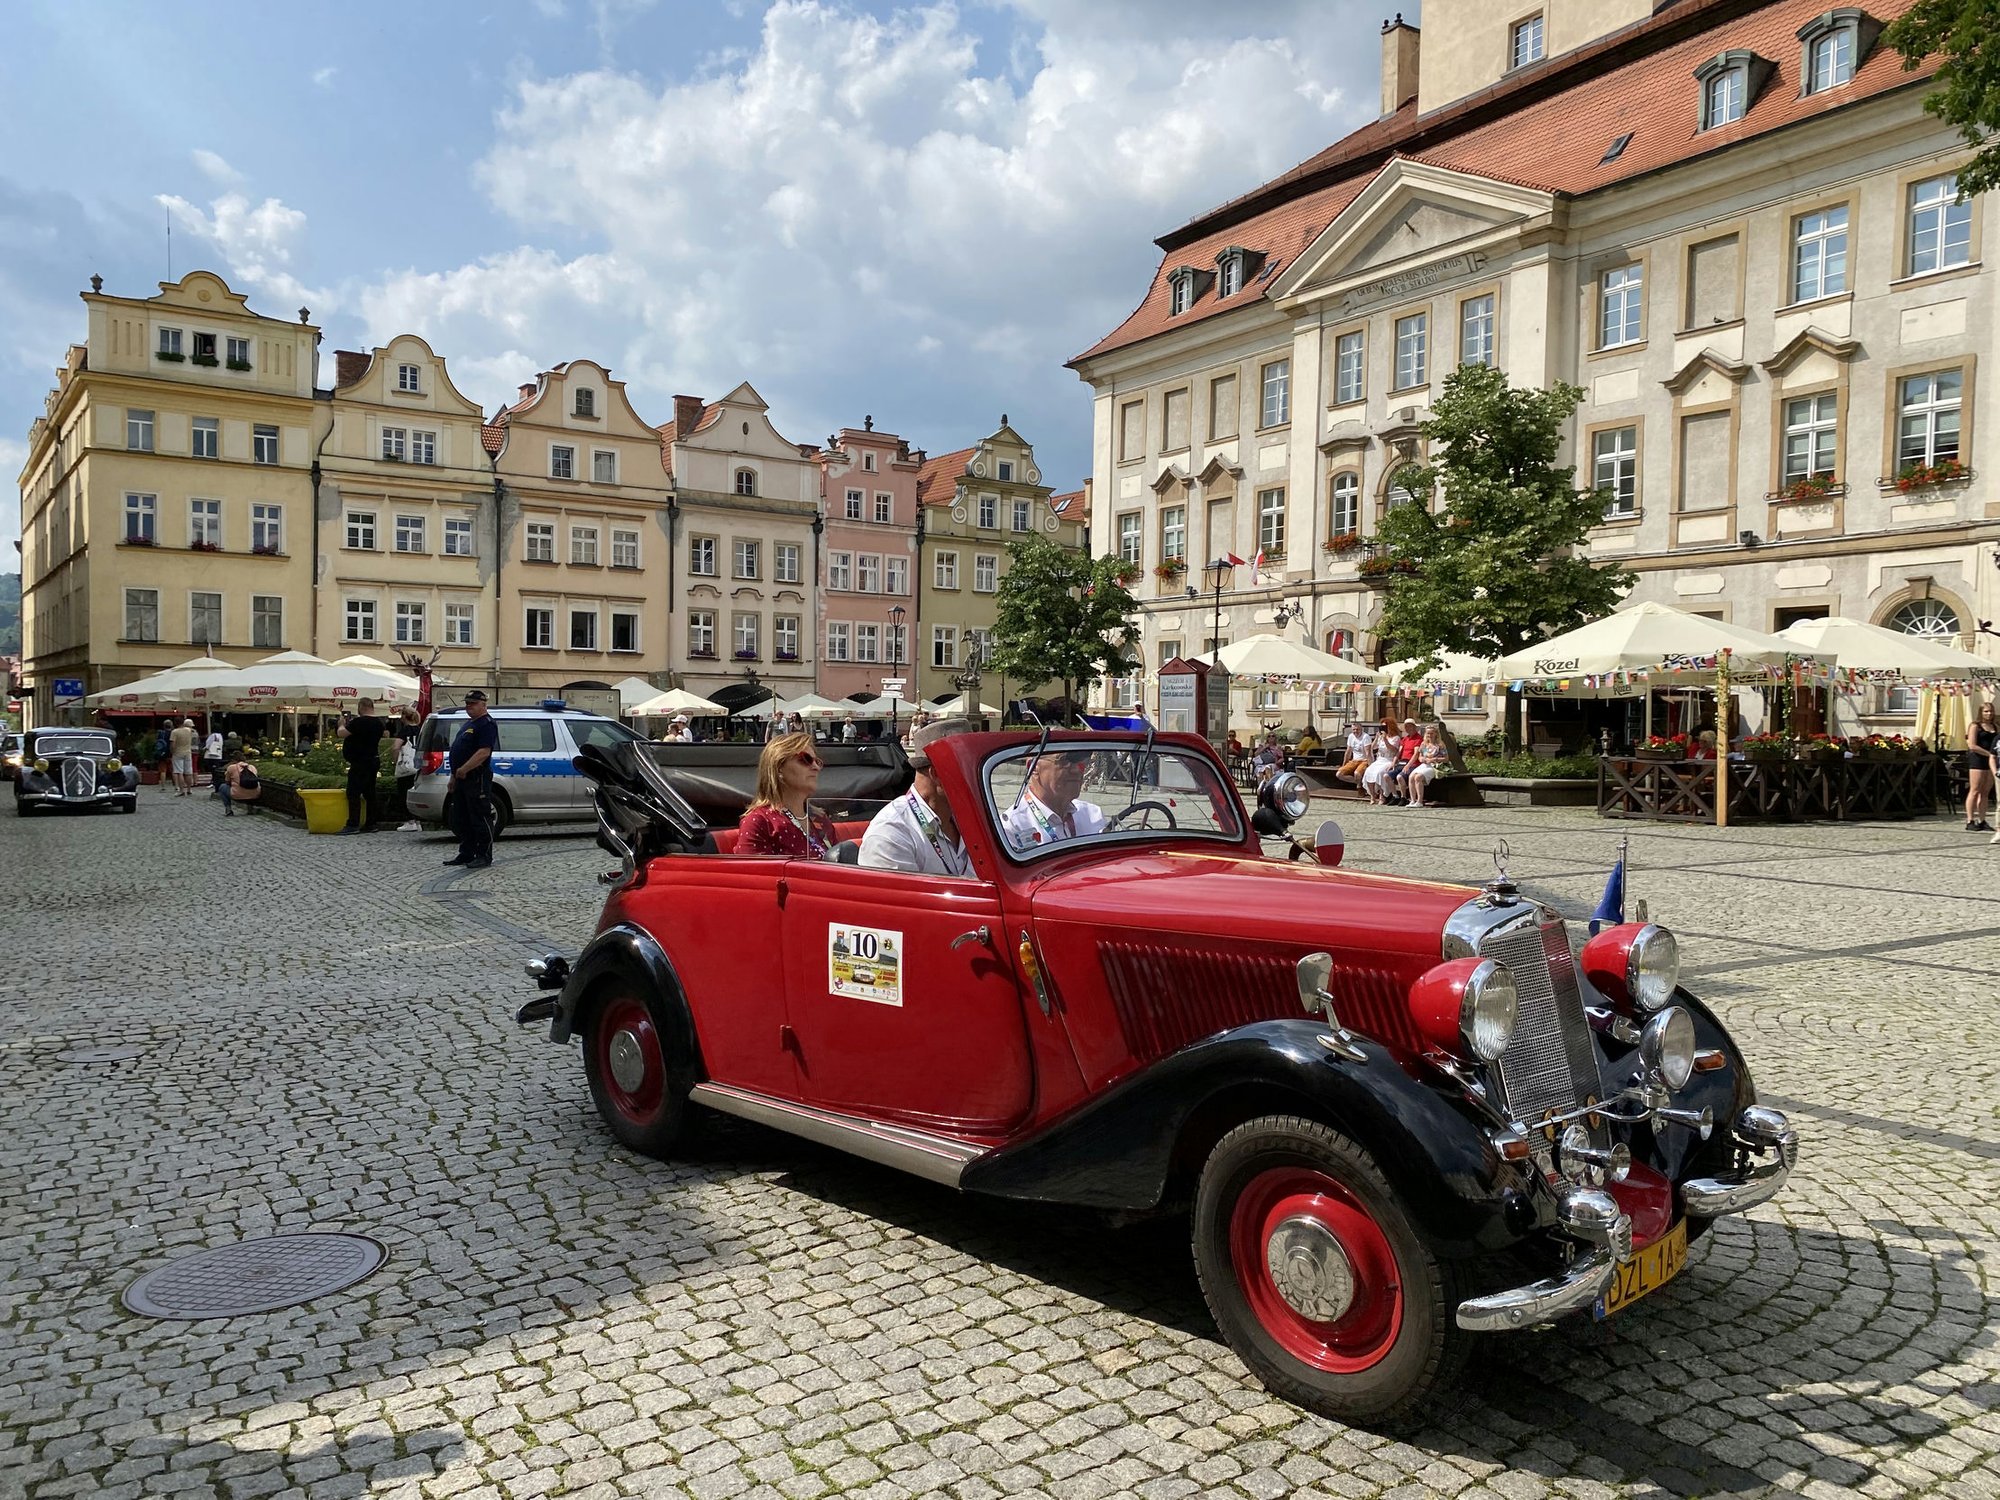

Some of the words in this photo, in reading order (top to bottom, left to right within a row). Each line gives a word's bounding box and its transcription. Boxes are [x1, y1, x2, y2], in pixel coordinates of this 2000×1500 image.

[1534, 658, 1580, 674] Kozel
[1352, 675, 1374, 684] Kozel
[852, 932, 877, 958] 10
